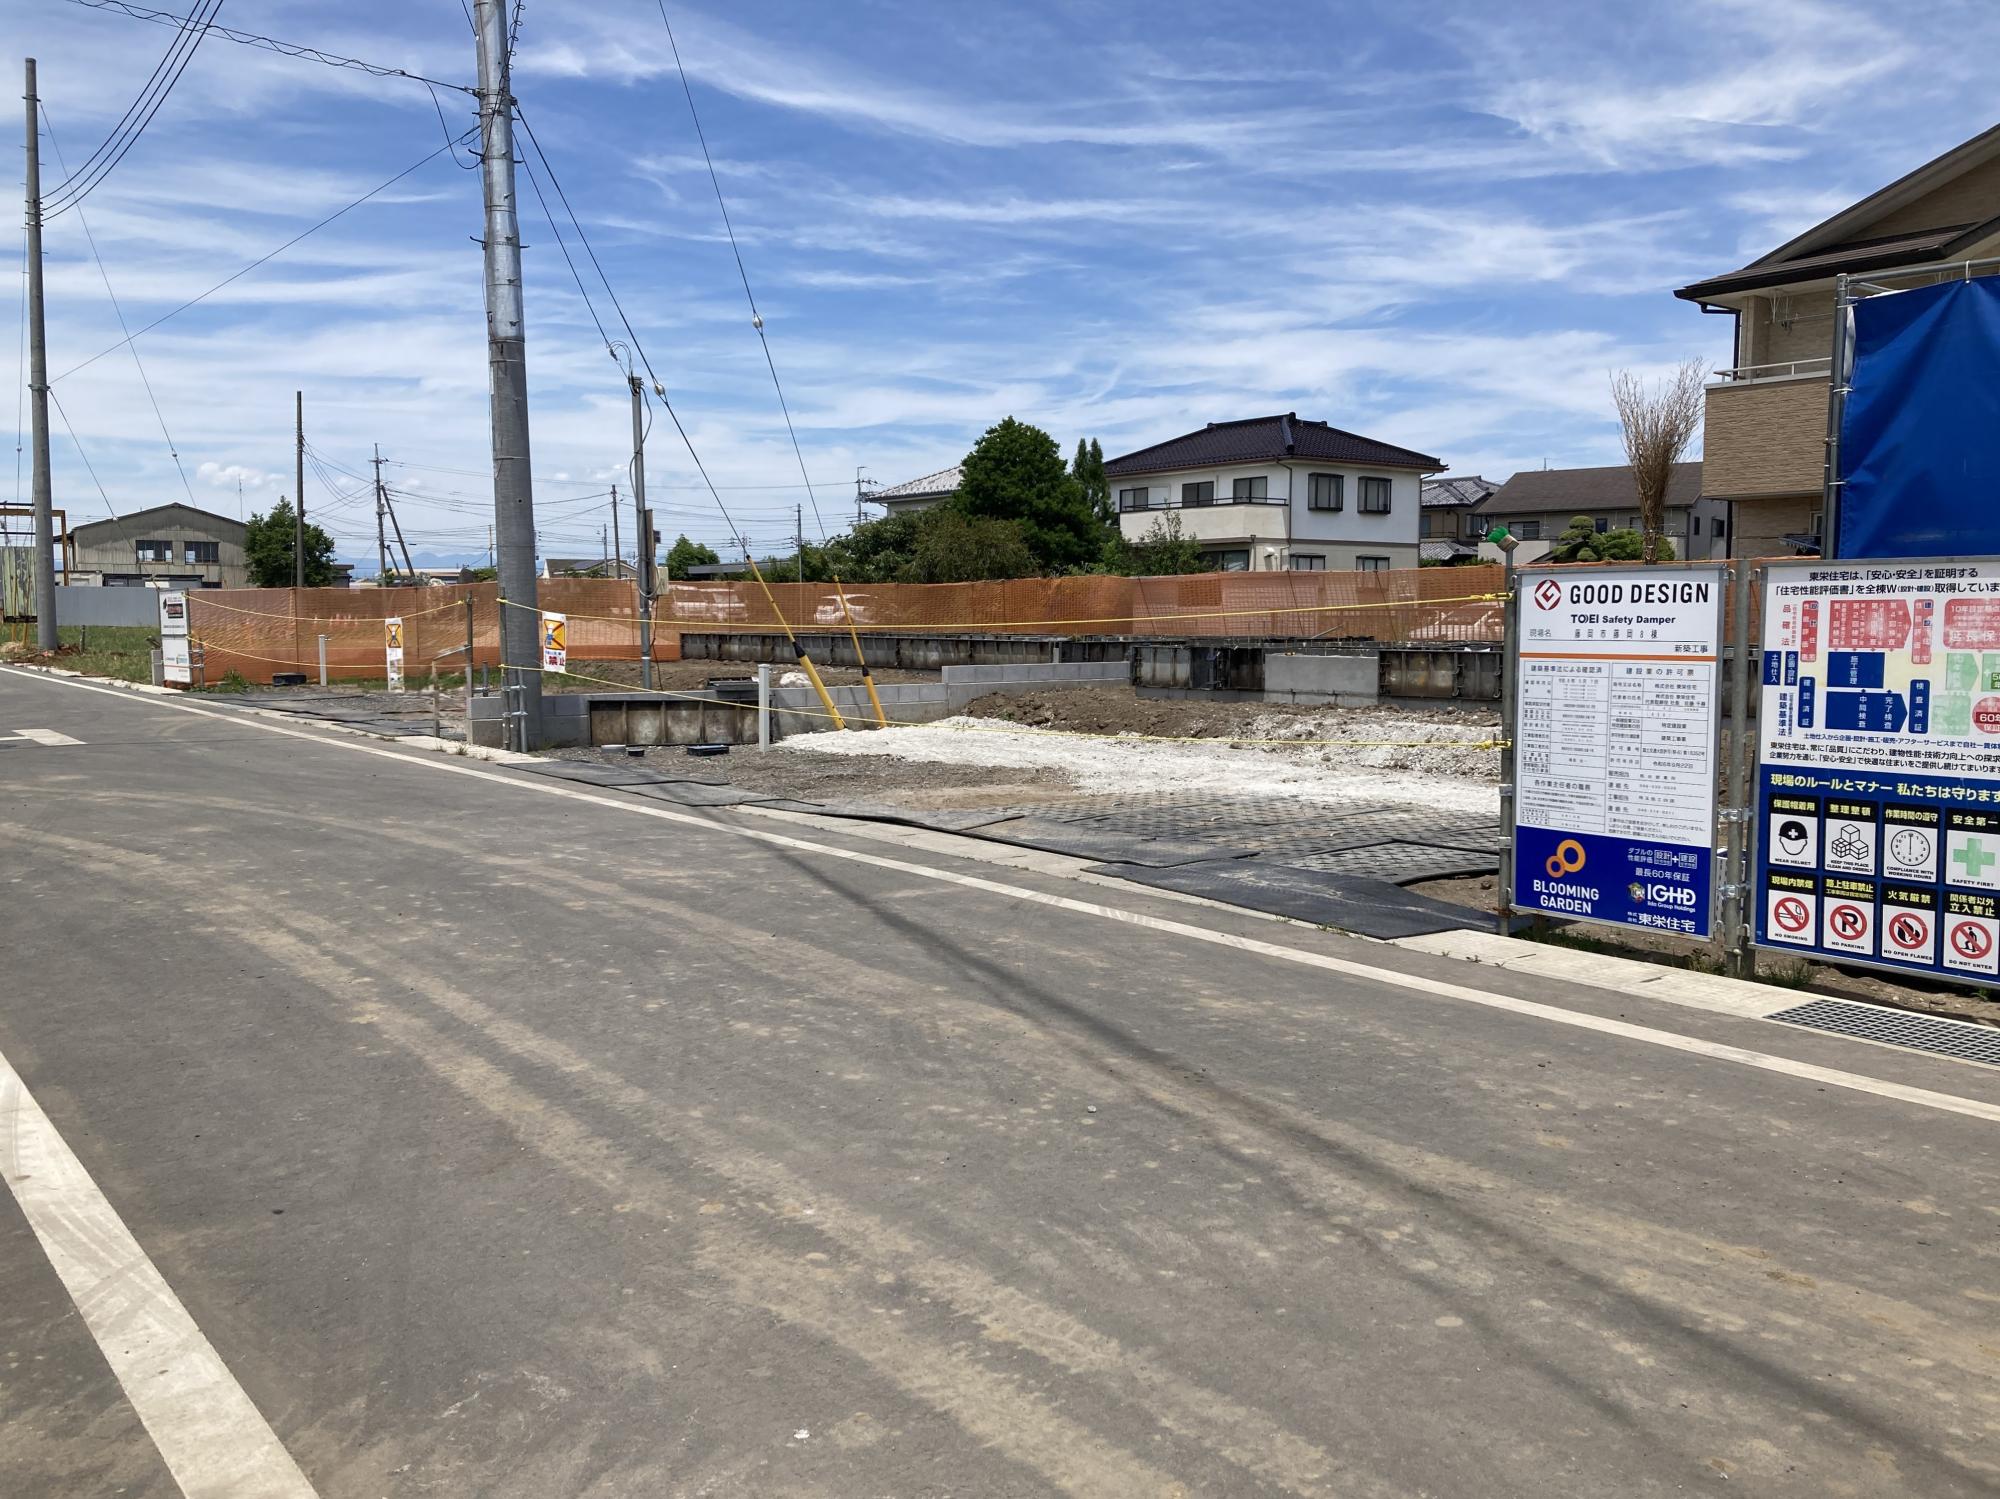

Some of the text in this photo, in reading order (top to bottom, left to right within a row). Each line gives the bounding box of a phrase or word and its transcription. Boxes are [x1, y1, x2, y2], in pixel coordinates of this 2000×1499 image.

[1570, 583, 1709, 604] GOOD DESIGN
[1602, 615, 1633, 625] Safety
[1636, 616, 1676, 625] Damper
[1530, 629, 1552, 637] 現場名
[1674, 645, 1708, 653] 新築工事
[1771, 654, 1779, 682] 土地仕入
[1850, 656, 1858, 684] 施工管理
[1778, 693, 1787, 736] 建築基準法
[1858, 697, 1867, 728] 中間検査
[1884, 697, 1893, 729] 完了検査
[1770, 773, 1893, 792] 現場のルールとマナー
[1885, 809, 1938, 822] 作業時間の遵守
[1953, 815, 1998, 826] 安全第一
[1635, 868, 1690, 882] 最長60年保証
[1534, 879, 1599, 900] BLOOMING
[1648, 884, 1696, 906] IGHD
[1888, 891, 1931, 904] 火気厳禁
[1540, 896, 1591, 914] GARDEN
[1950, 894, 1994, 905] 関係者以外
[1950, 903, 1995, 916] 立入禁止
[1638, 913, 1695, 932] 東栄住宅
